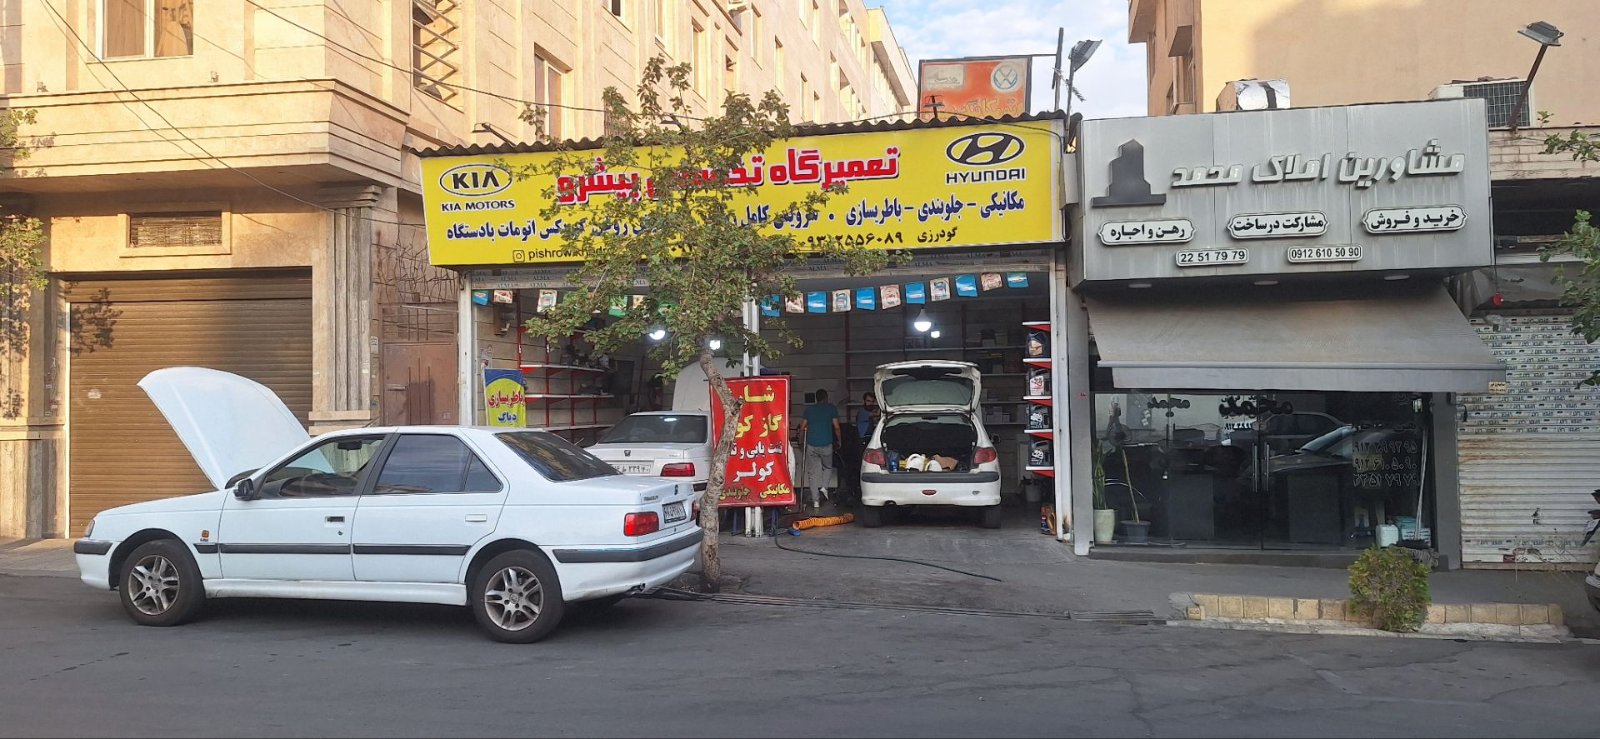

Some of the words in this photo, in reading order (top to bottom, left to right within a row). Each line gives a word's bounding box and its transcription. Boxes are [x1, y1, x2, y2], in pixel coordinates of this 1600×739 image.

[769, 147, 898, 190] تعمیرگاه
[1252, 153, 1331, 182] املاک
[1339, 139, 1464, 188] مشاورین
[452, 171, 500, 190] KIA
[557, 157, 639, 203] پیشرو
[946, 168, 1025, 183] HYUNDAI
[1172, 164, 1243, 187] محمد
[441, 203, 461, 212] KIA
[465, 200, 515, 211] MOTORS
[846, 198, 901, 225] باطریسازی
[917, 194, 963, 222] جلوبندی
[980, 190, 1024, 218] مکانیکی
[1282, 215, 1324, 232] مشارکت
[1371, 211, 1411, 230] فروش
[1414, 216, 1420, 228] و
[1423, 209, 1460, 227] خرید
[498, 219, 536, 241] اتومات
[1110, 224, 1145, 241] اجاره
[1148, 228, 1154, 239] و
[1155, 225, 1186, 239] رهن
[1180, 253, 1194, 263] 22
[1197, 252, 1210, 262] 51
[1214, 251, 1228, 261] 79
[1231, 250, 1245, 260] 79
[1291, 249, 1313, 259] 0912
[1315, 248, 1332, 257] 610
[1335, 248, 1346, 257] 50
[1348, 247, 1360, 256] 90
[732, 461, 775, 482] کولر
